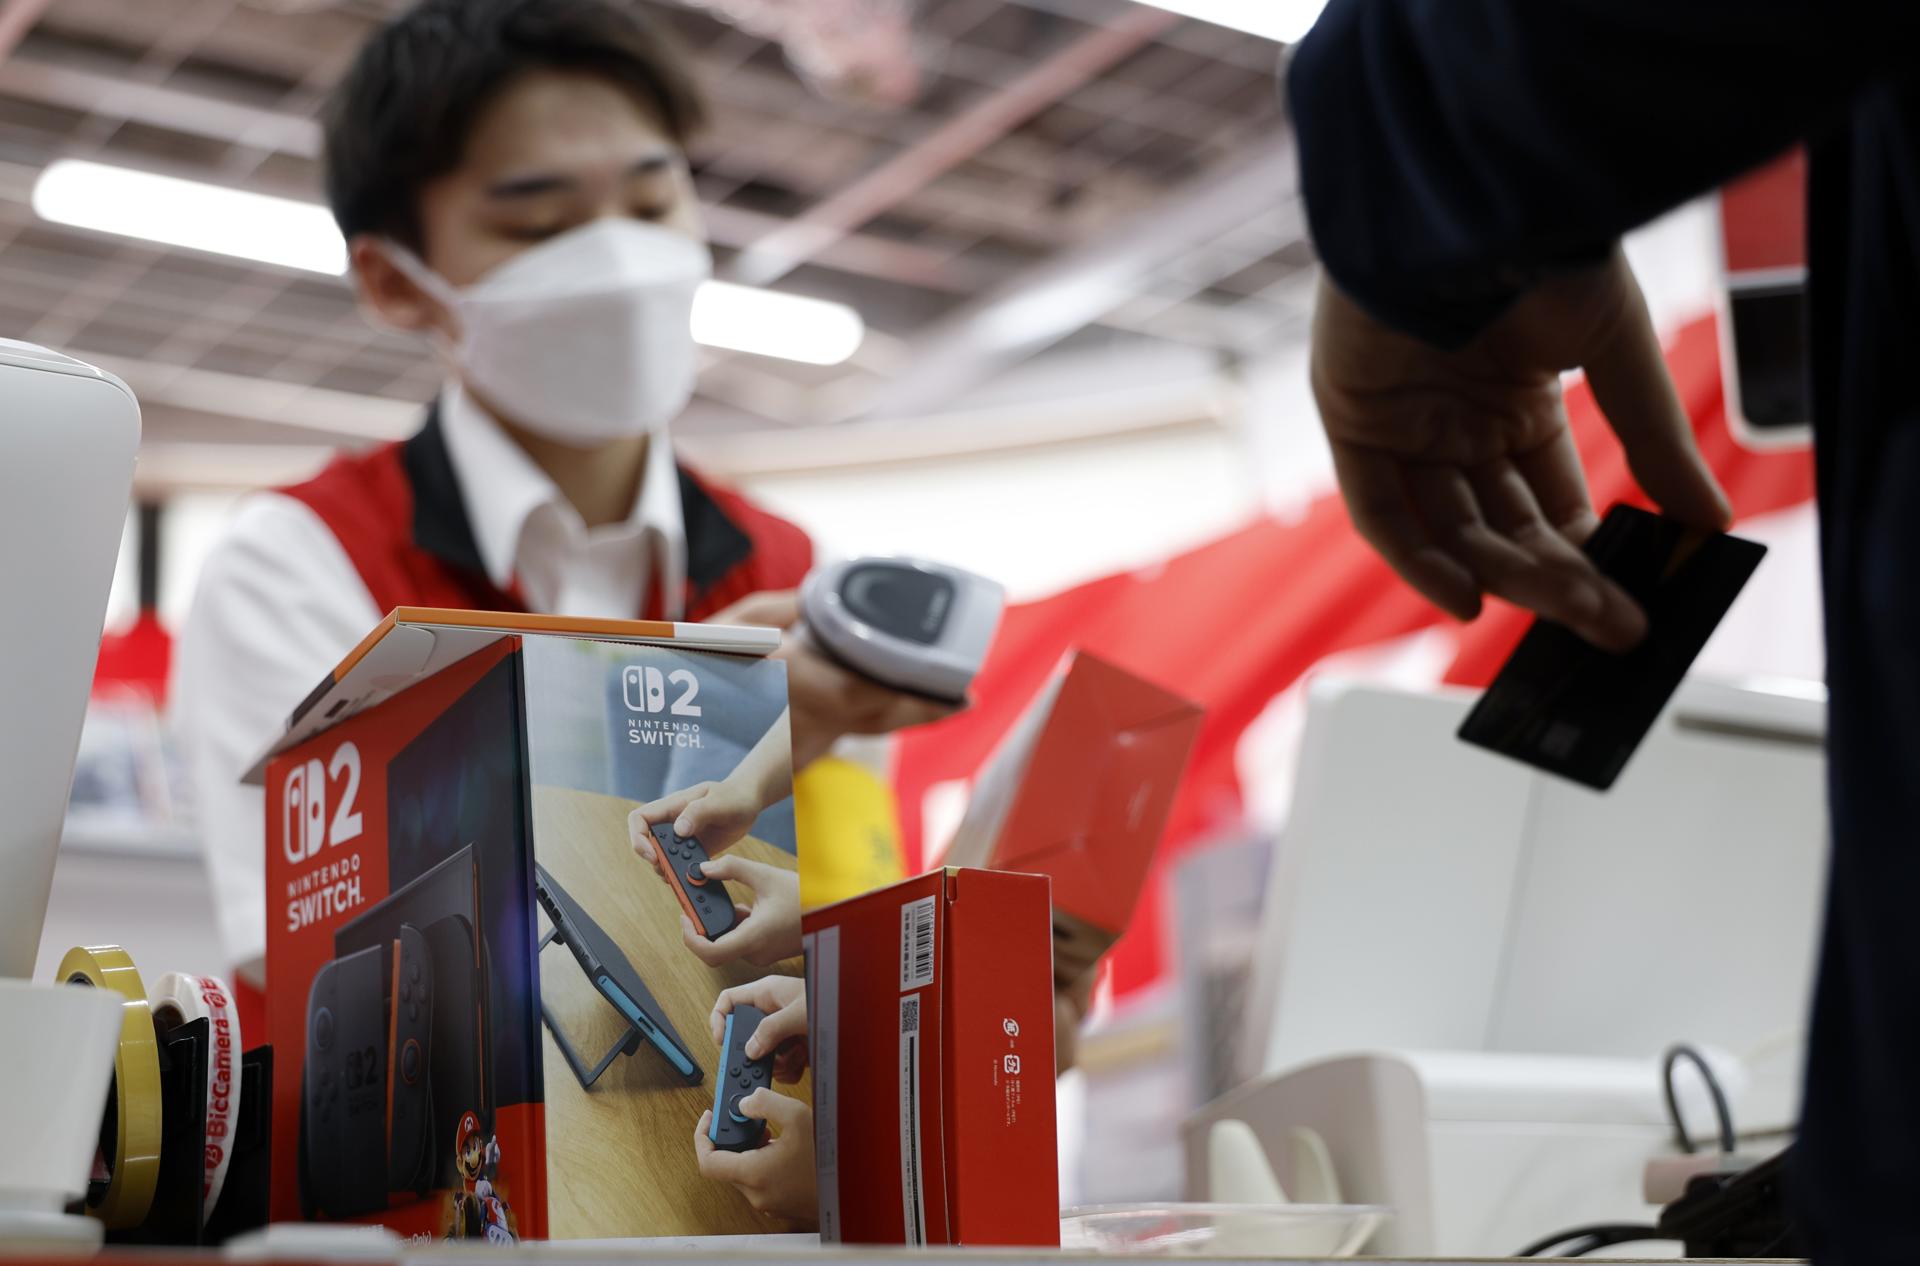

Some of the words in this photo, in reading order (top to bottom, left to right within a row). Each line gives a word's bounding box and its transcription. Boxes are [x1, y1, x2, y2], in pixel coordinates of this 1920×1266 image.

[668, 669, 702, 717] 2
[628, 719, 700, 732] NINTENDO
[328, 741, 363, 847] 2
[287, 853, 360, 897] NINTENDO
[207, 1016, 231, 1138] BicCamera
